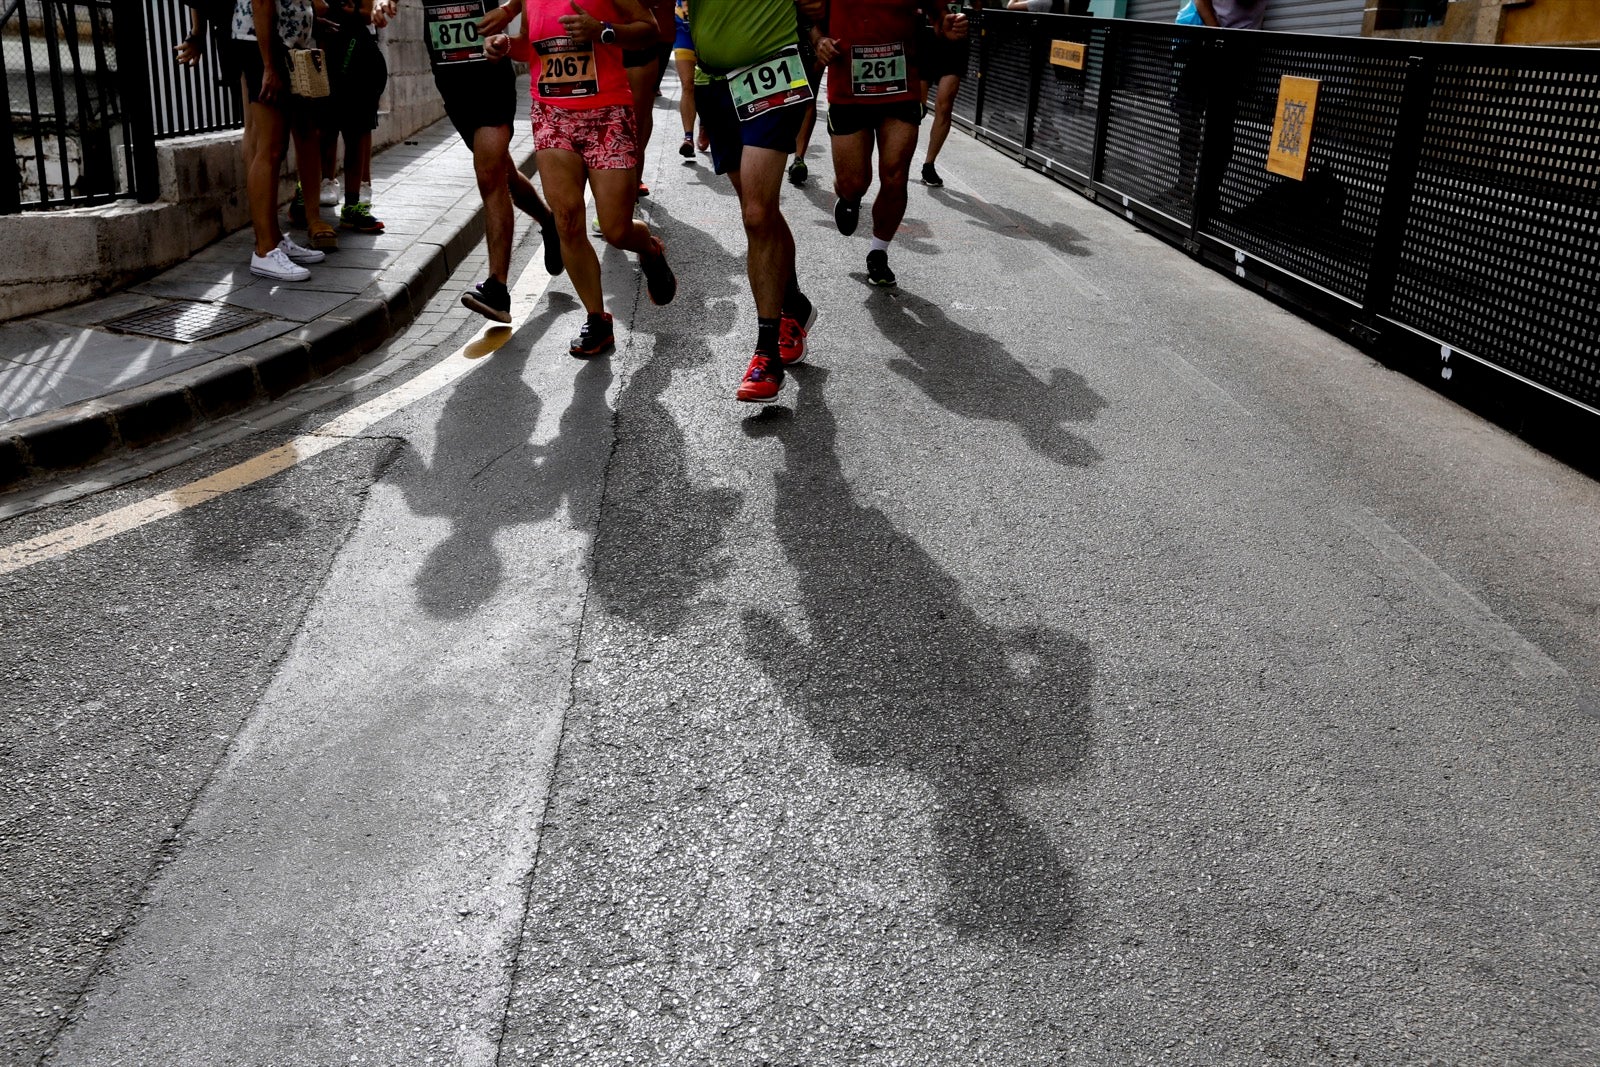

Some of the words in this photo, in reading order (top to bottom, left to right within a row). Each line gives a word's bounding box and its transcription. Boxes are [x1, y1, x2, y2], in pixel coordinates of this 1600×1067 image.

[439, 21, 478, 45] 870
[546, 55, 590, 78] 2067
[743, 60, 792, 96] 191
[861, 59, 896, 79] 261
